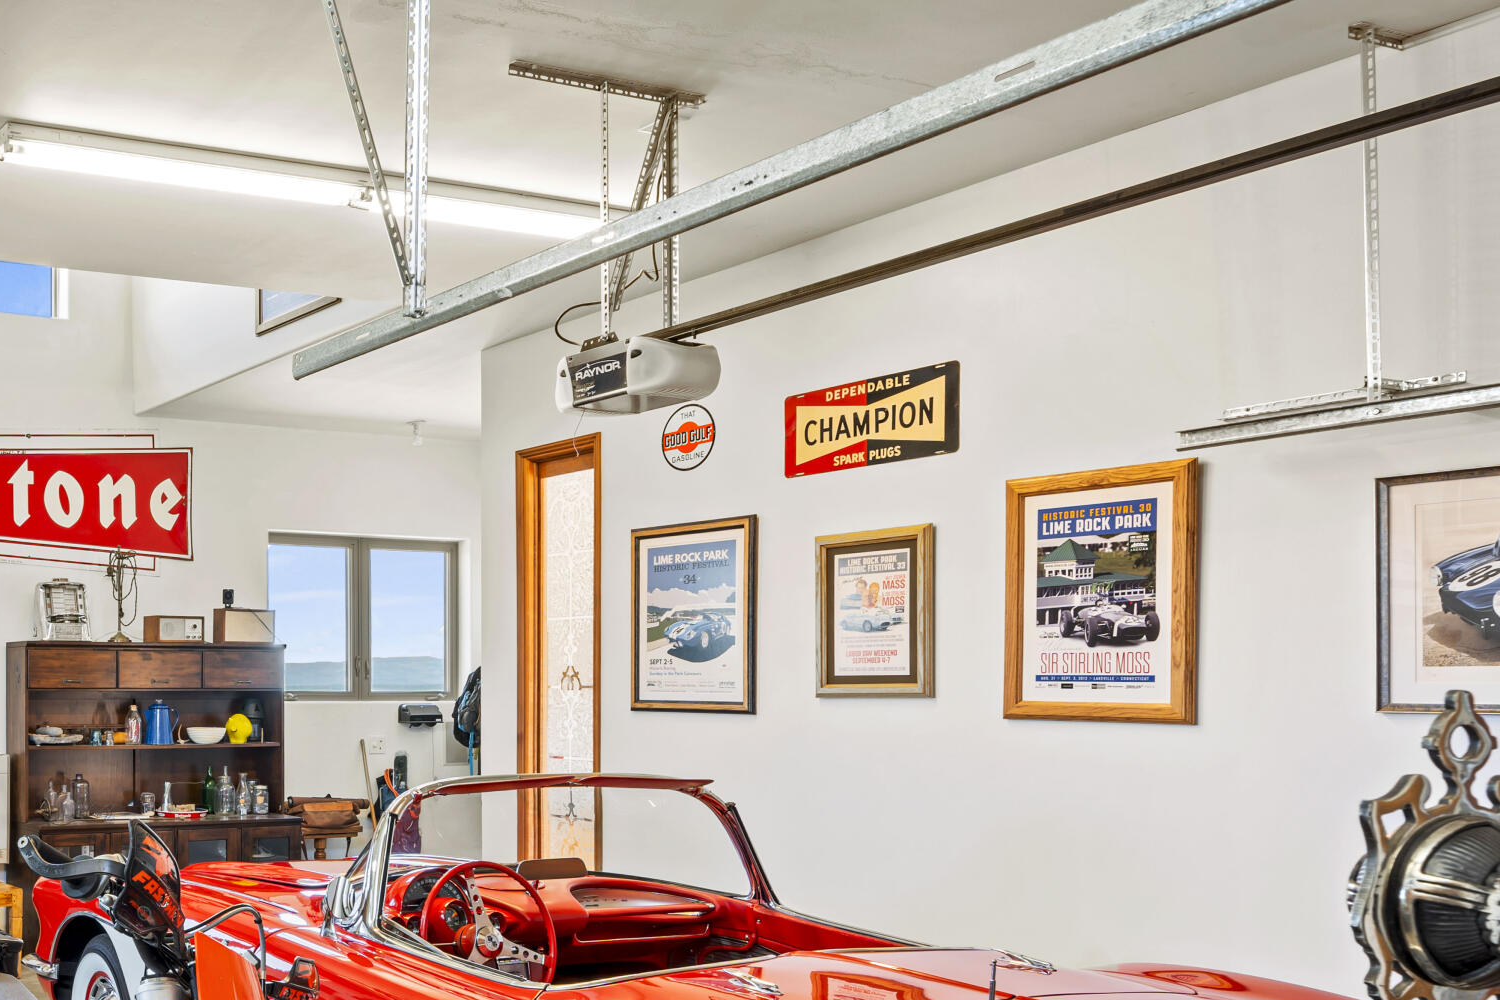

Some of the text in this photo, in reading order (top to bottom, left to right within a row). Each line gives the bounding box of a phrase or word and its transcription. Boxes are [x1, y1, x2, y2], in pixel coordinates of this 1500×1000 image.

[575, 361, 621, 381] RAYNOR
[825, 374, 911, 402] DEPENDABLE
[681, 410, 696, 420] THAT
[804, 396, 934, 446] CHAMPION
[665, 426, 713, 448] GOOD GULF
[672, 450, 706, 463] GASOLINE
[833, 445, 901, 467] SPARK PLUGS
[1042, 502, 1152, 522] HISTORIC FESTIVAL 30
[1042, 512, 1152, 536] LIME ROCK PARK
[653, 549, 729, 566] LIME ROCK PARK
[654, 559, 729, 573] HISTORIC FESTIVAL
[867, 563, 895, 573] FESTIVAL
[897, 561, 906, 570] 33
[683, 574, 697, 585] 34
[882, 580, 906, 590] MASS
[882, 595, 905, 606] MOSS
[1041, 651, 1151, 674] SIR STIRLING MOSS
